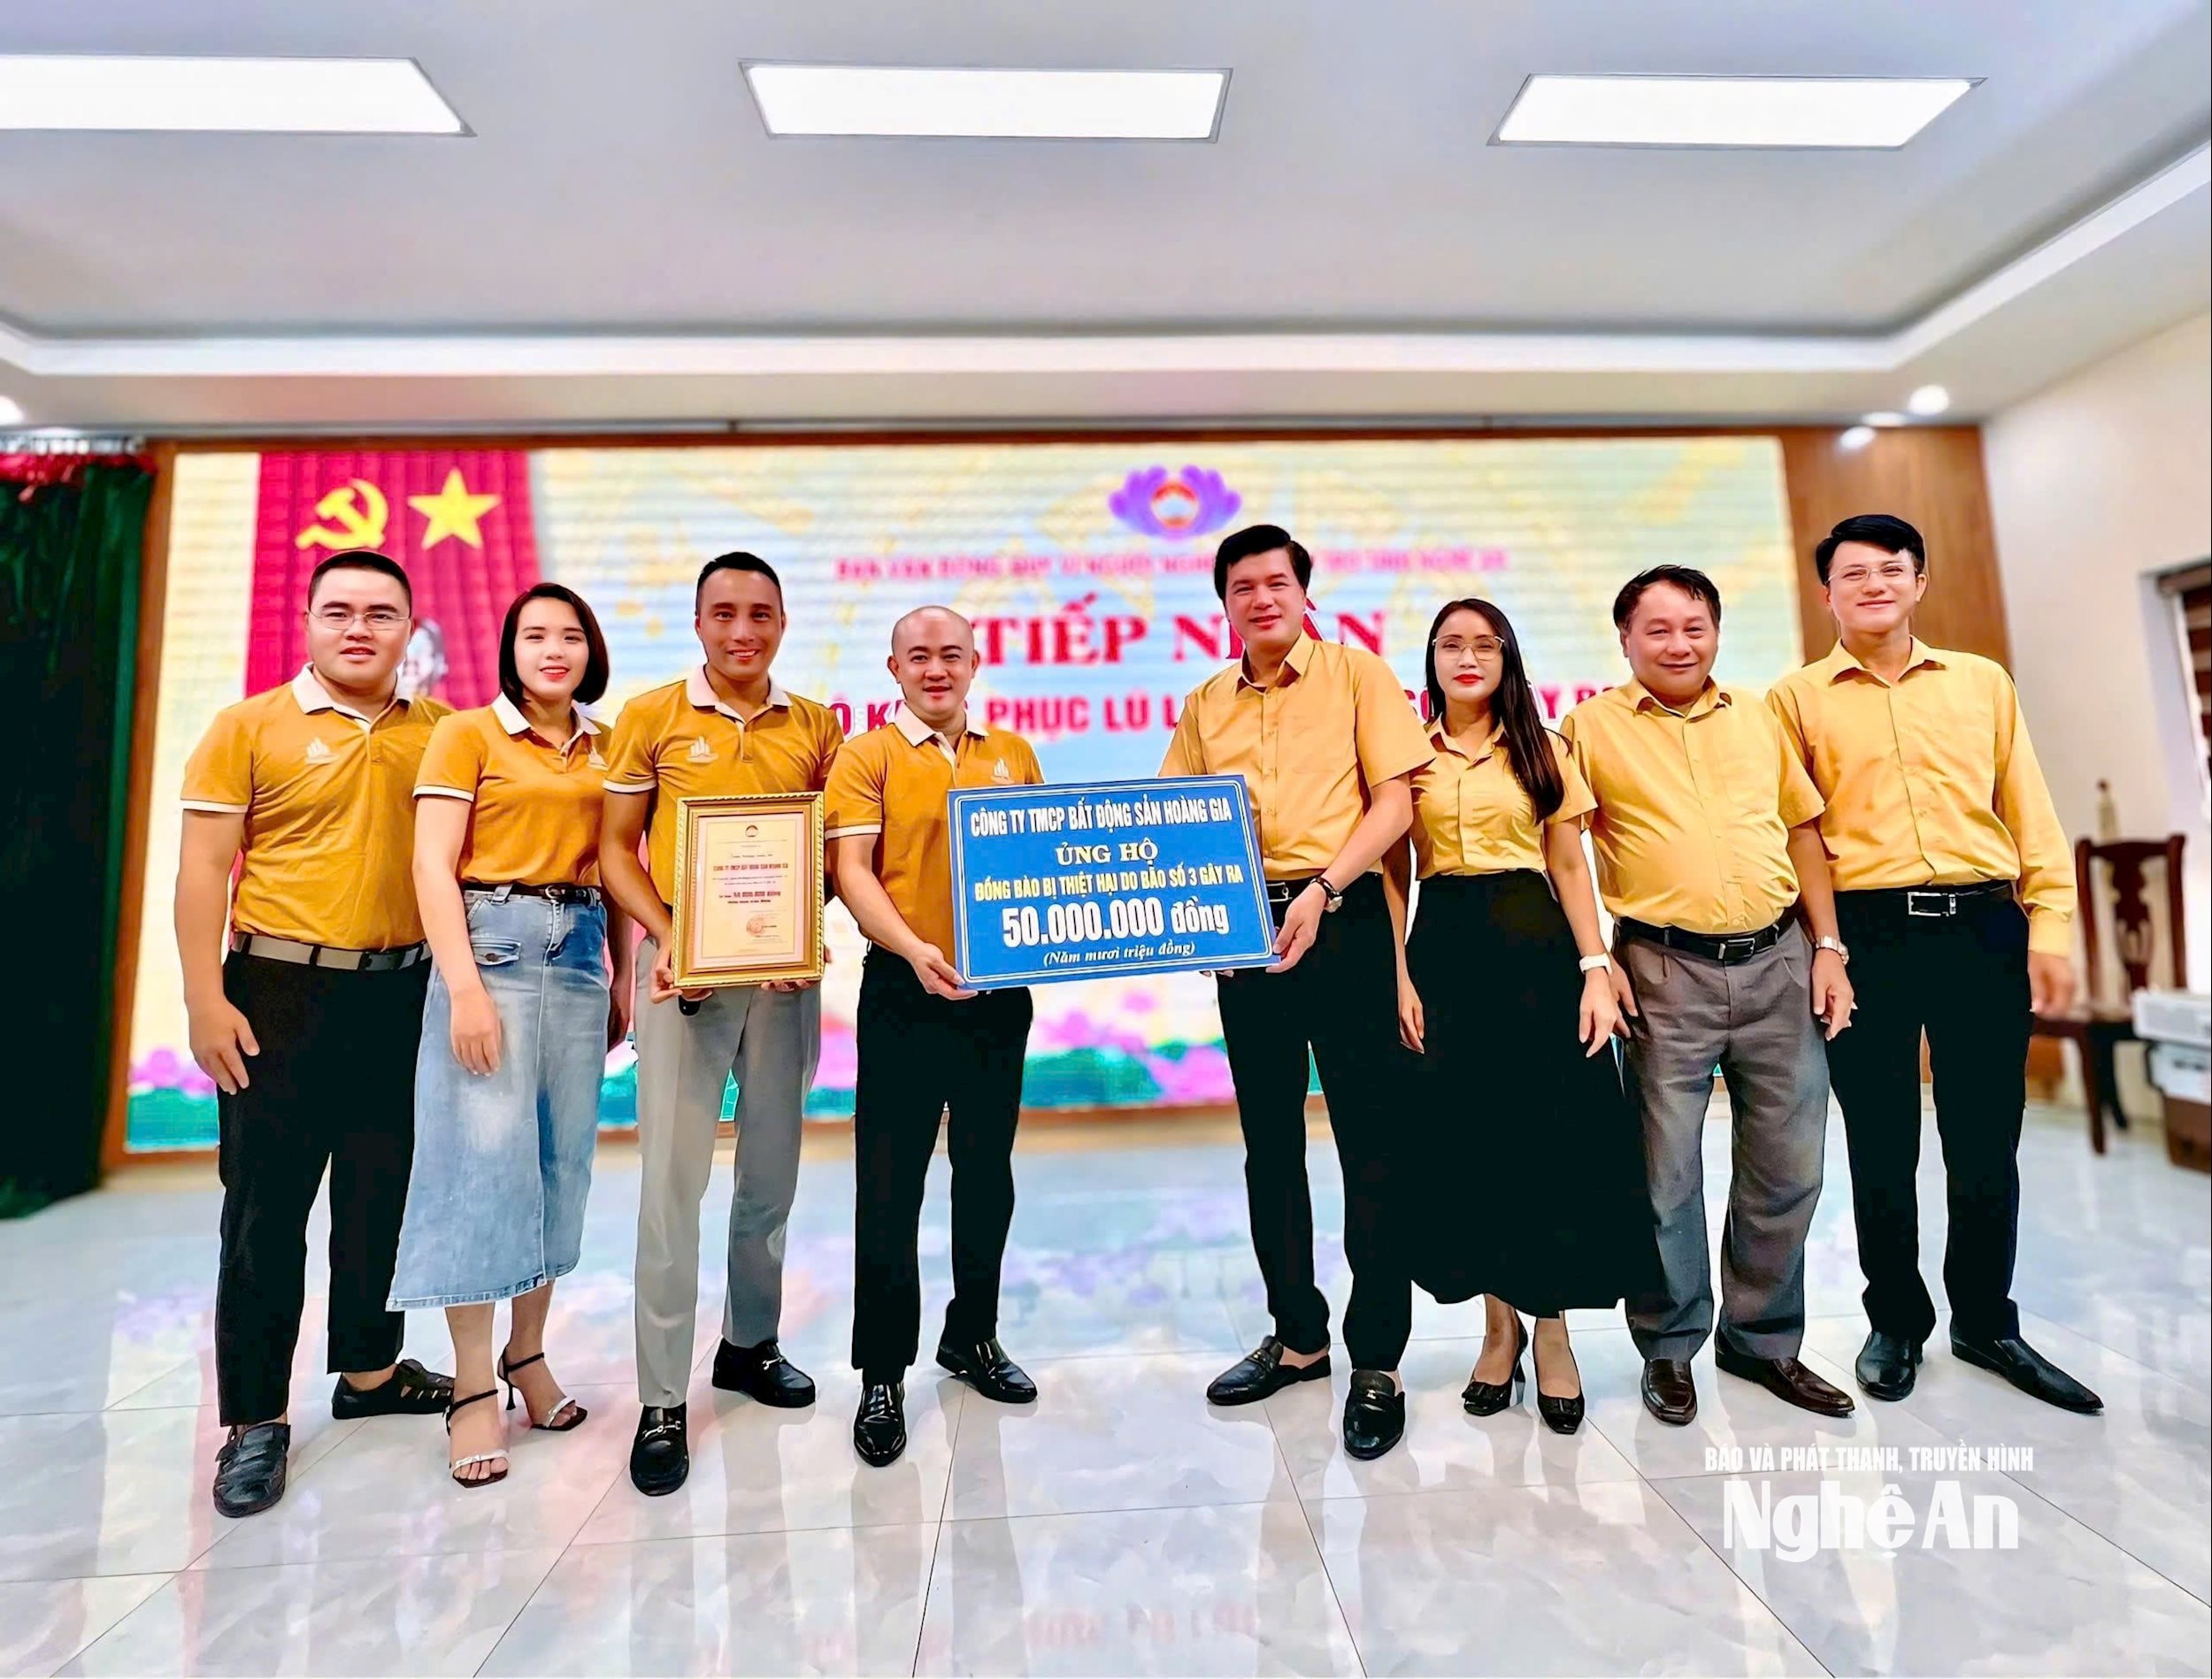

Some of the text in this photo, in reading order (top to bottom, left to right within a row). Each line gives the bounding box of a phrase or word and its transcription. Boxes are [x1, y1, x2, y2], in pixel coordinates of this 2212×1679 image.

[972, 592, 1148, 666] TIẾP
[986, 695, 1090, 742] PHỤC
[971, 794, 1233, 837] CÔNG TY TMCP BẤT ĐỘNG SẢN HOÀNG GIA
[1056, 837, 1159, 866] ỦNG HỘ
[1013, 875, 1040, 898] BÀO
[1042, 877, 1057, 900] BỊ
[1059, 870, 1094, 898] THIỆT
[1095, 872, 1118, 897] HẠI
[1119, 870, 1138, 891] DO
[1141, 866, 1166, 890] BÃO
[1169, 862, 1187, 888] SỐ
[1188, 867, 1198, 886] 3
[1199, 862, 1223, 886] GÂY
[1225, 863, 1244, 884] RA
[1002, 895, 1230, 948] 50.000.000 đồng
[1043, 950, 1080, 968] (Năm
[1123, 944, 1155, 961] triệu
[1157, 939, 1196, 957] đồng)
